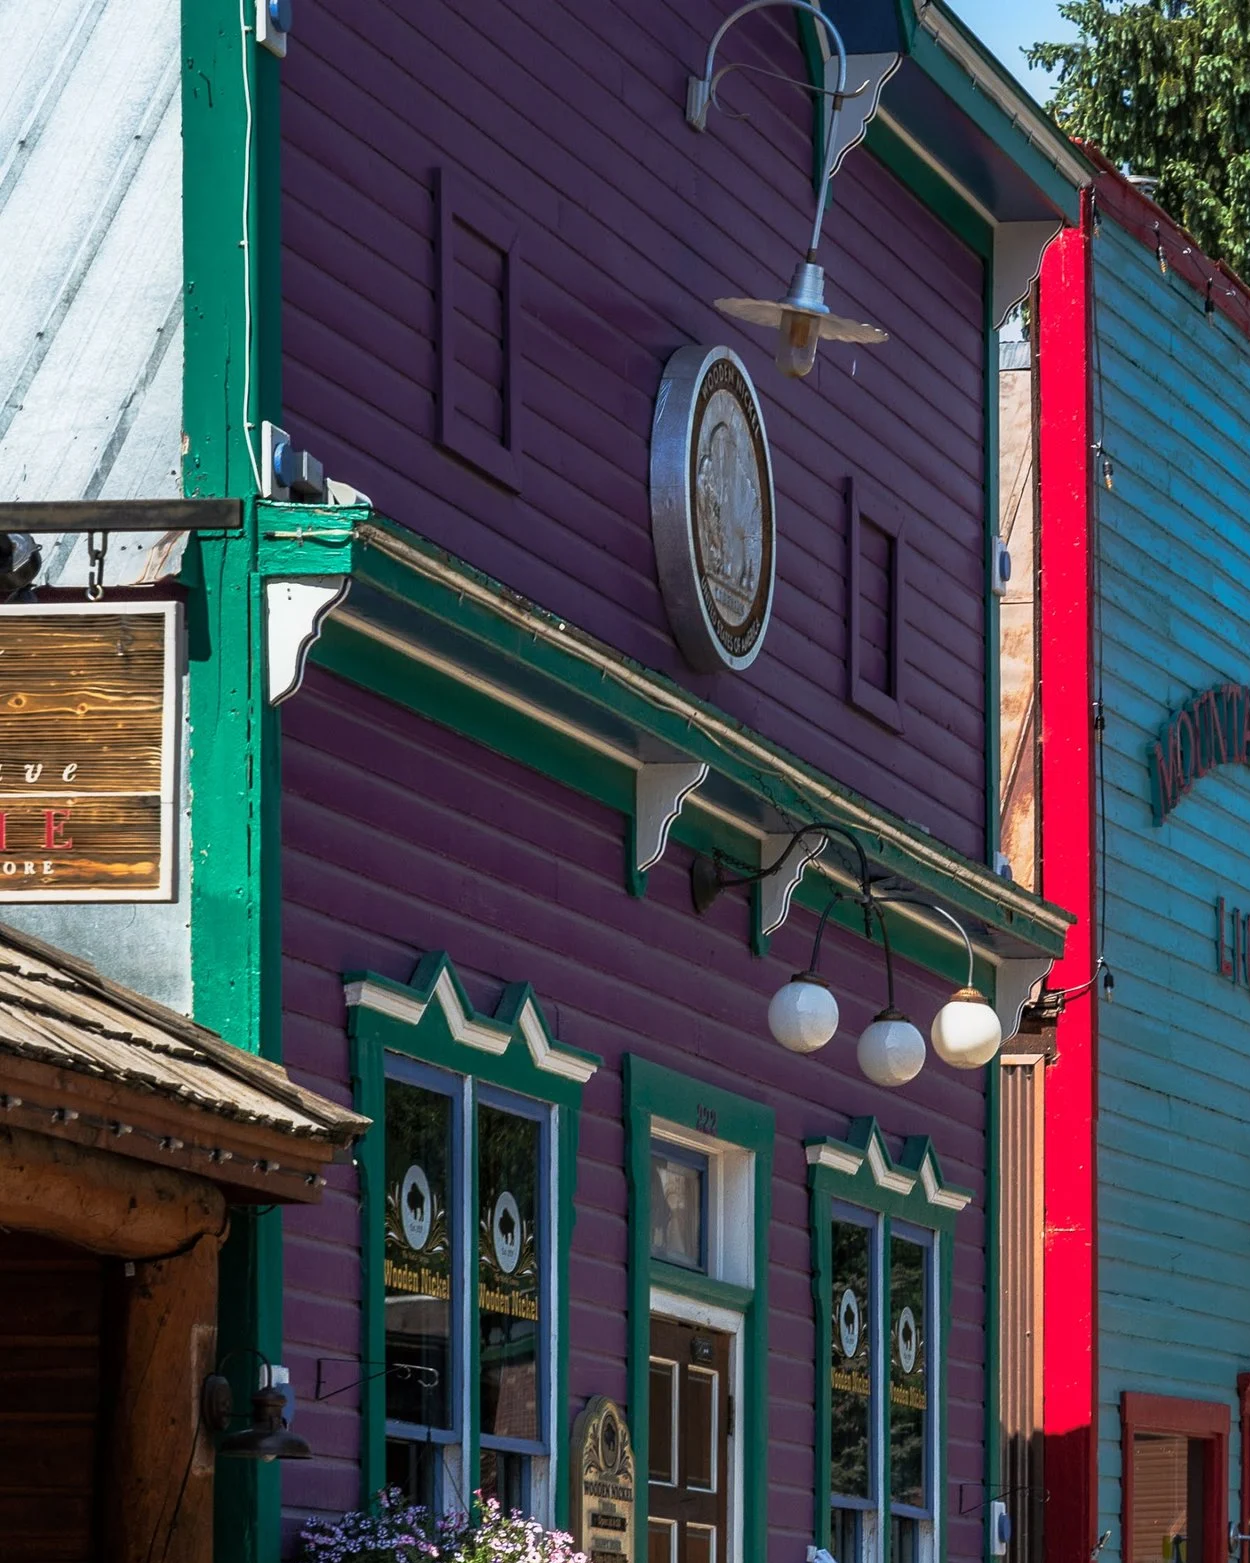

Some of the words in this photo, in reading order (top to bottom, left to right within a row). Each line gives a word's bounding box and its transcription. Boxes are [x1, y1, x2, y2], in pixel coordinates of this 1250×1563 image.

[701, 363, 735, 400] WOODEN
[736, 377, 760, 440] NICKEL
[384, 1258, 420, 1293] Wooden
[421, 1267, 450, 1300] Nickel
[478, 1281, 510, 1315] Wooden
[511, 1290, 539, 1321] Nickel
